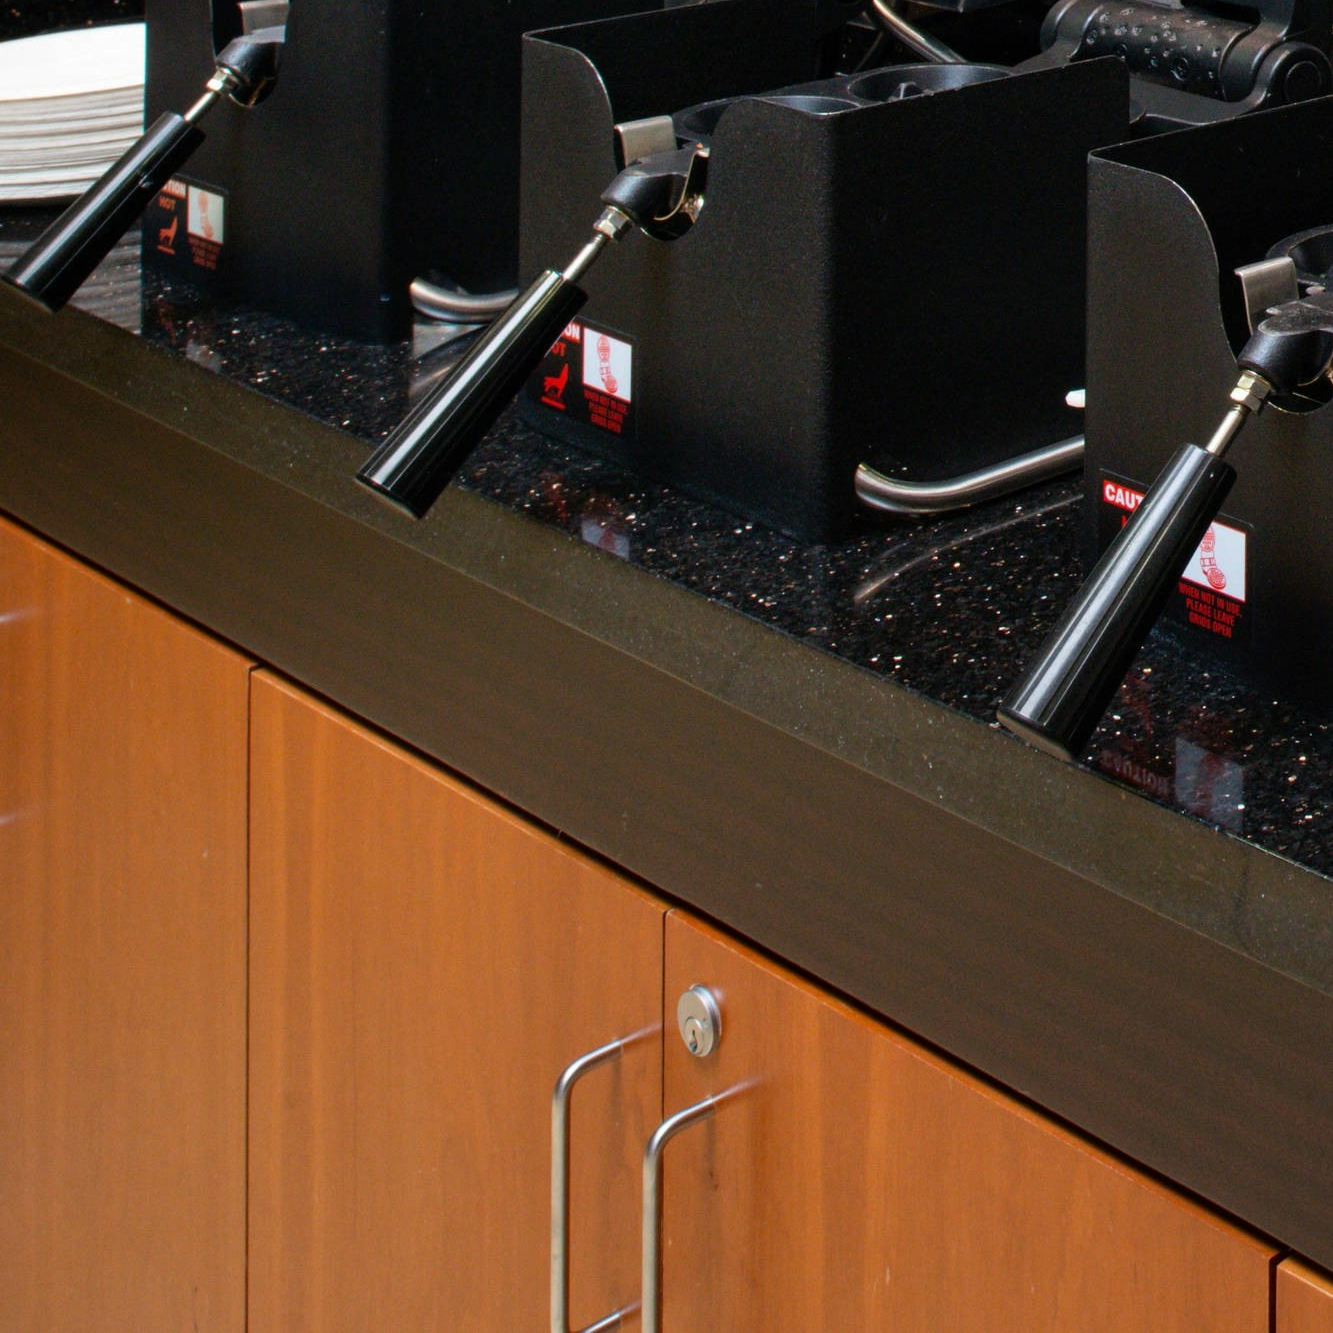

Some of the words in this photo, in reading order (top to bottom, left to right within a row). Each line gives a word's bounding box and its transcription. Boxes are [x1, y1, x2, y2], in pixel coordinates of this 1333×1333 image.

[1104, 482, 1145, 510] CAUT
[1177, 582, 1201, 599] WHEN
[1200, 589, 1216, 605] NOT
[1215, 596, 1225, 609] IN
[1185, 598, 1213, 617] PLEASE
[1213, 608, 1236, 627] LEAVE
[1212, 619, 1233, 638] OPEN
